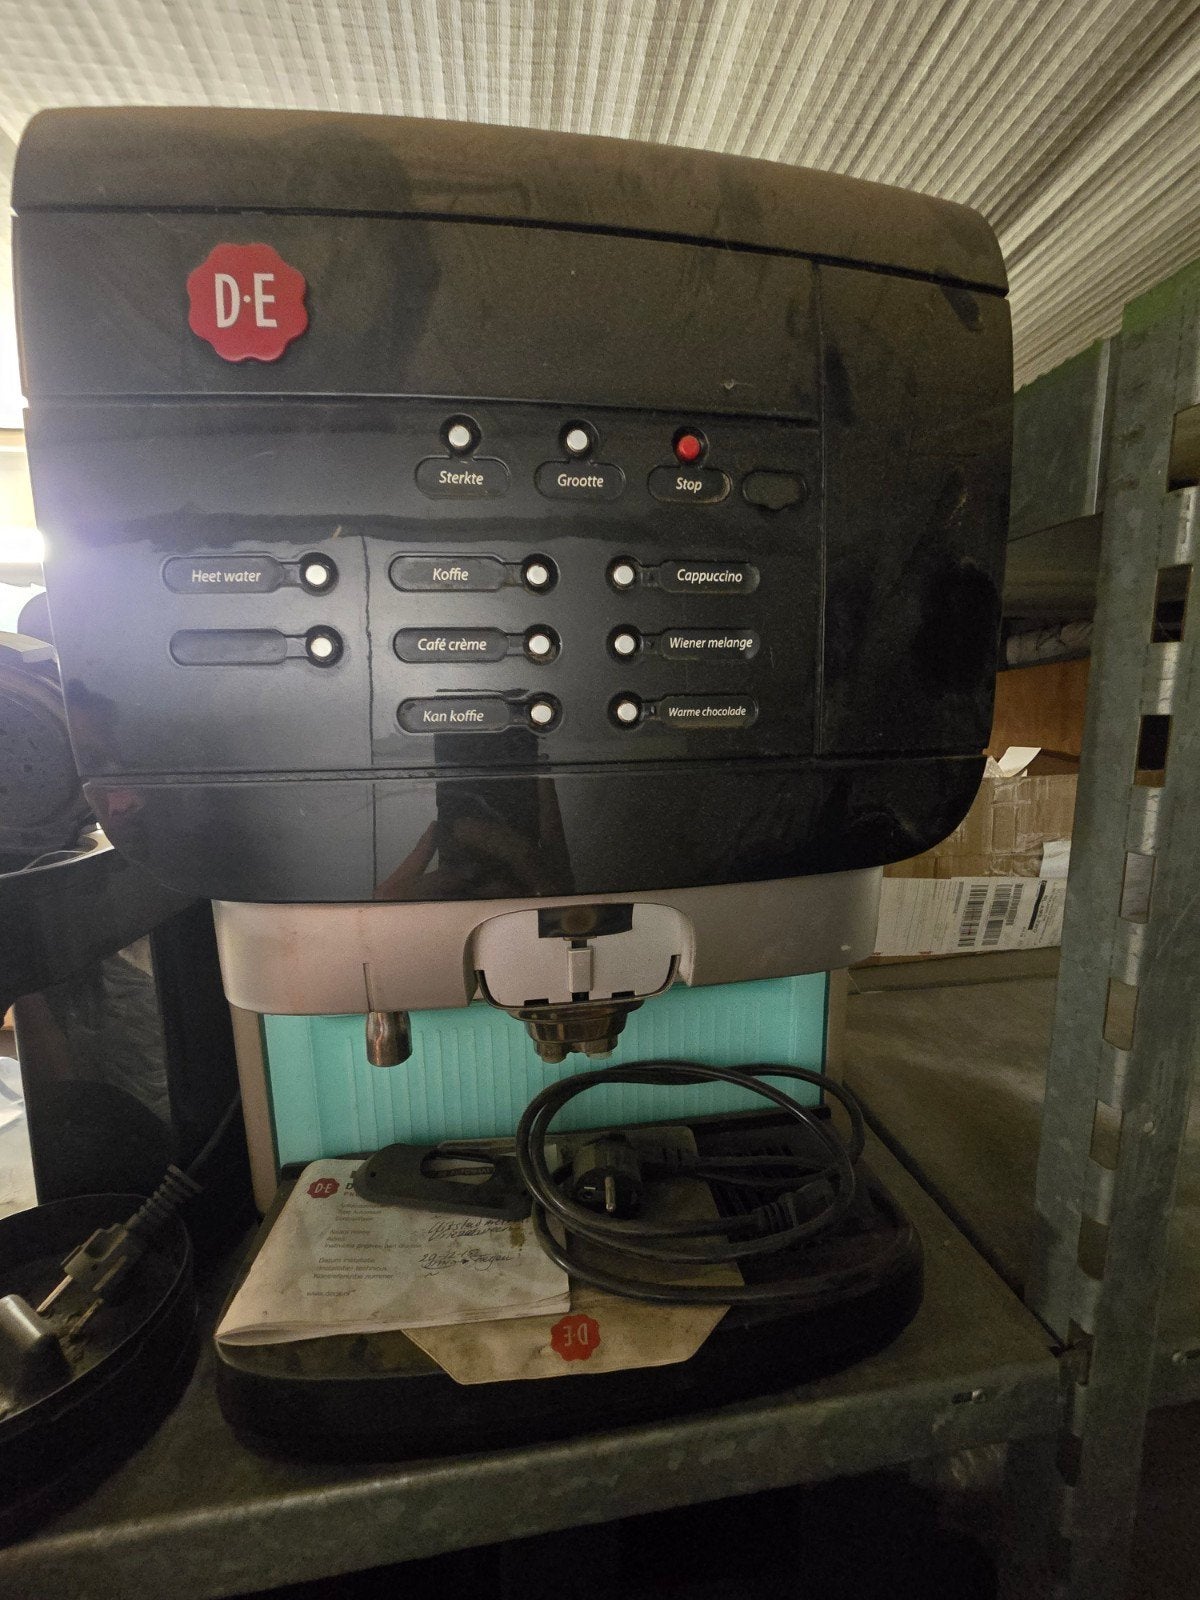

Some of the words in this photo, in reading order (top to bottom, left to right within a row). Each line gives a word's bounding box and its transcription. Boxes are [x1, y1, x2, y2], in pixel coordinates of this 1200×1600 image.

[439, 470, 484, 485] Sterkte
[557, 473, 604, 488] Grootte
[675, 476, 703, 494] Stop
[191, 569, 221, 583] Heet
[223, 570, 262, 583] water
[432, 567, 469, 581] Koffie
[676, 568, 743, 584] Cappuccino
[417, 638, 446, 651] Café
[448, 639, 487, 651] crème
[669, 636, 707, 649] Wiener
[707, 636, 753, 651] melange
[423, 710, 447, 722] Kan
[450, 710, 485, 722] koffie
[668, 707, 701, 717] Warme
[702, 705, 747, 717] chocolade
